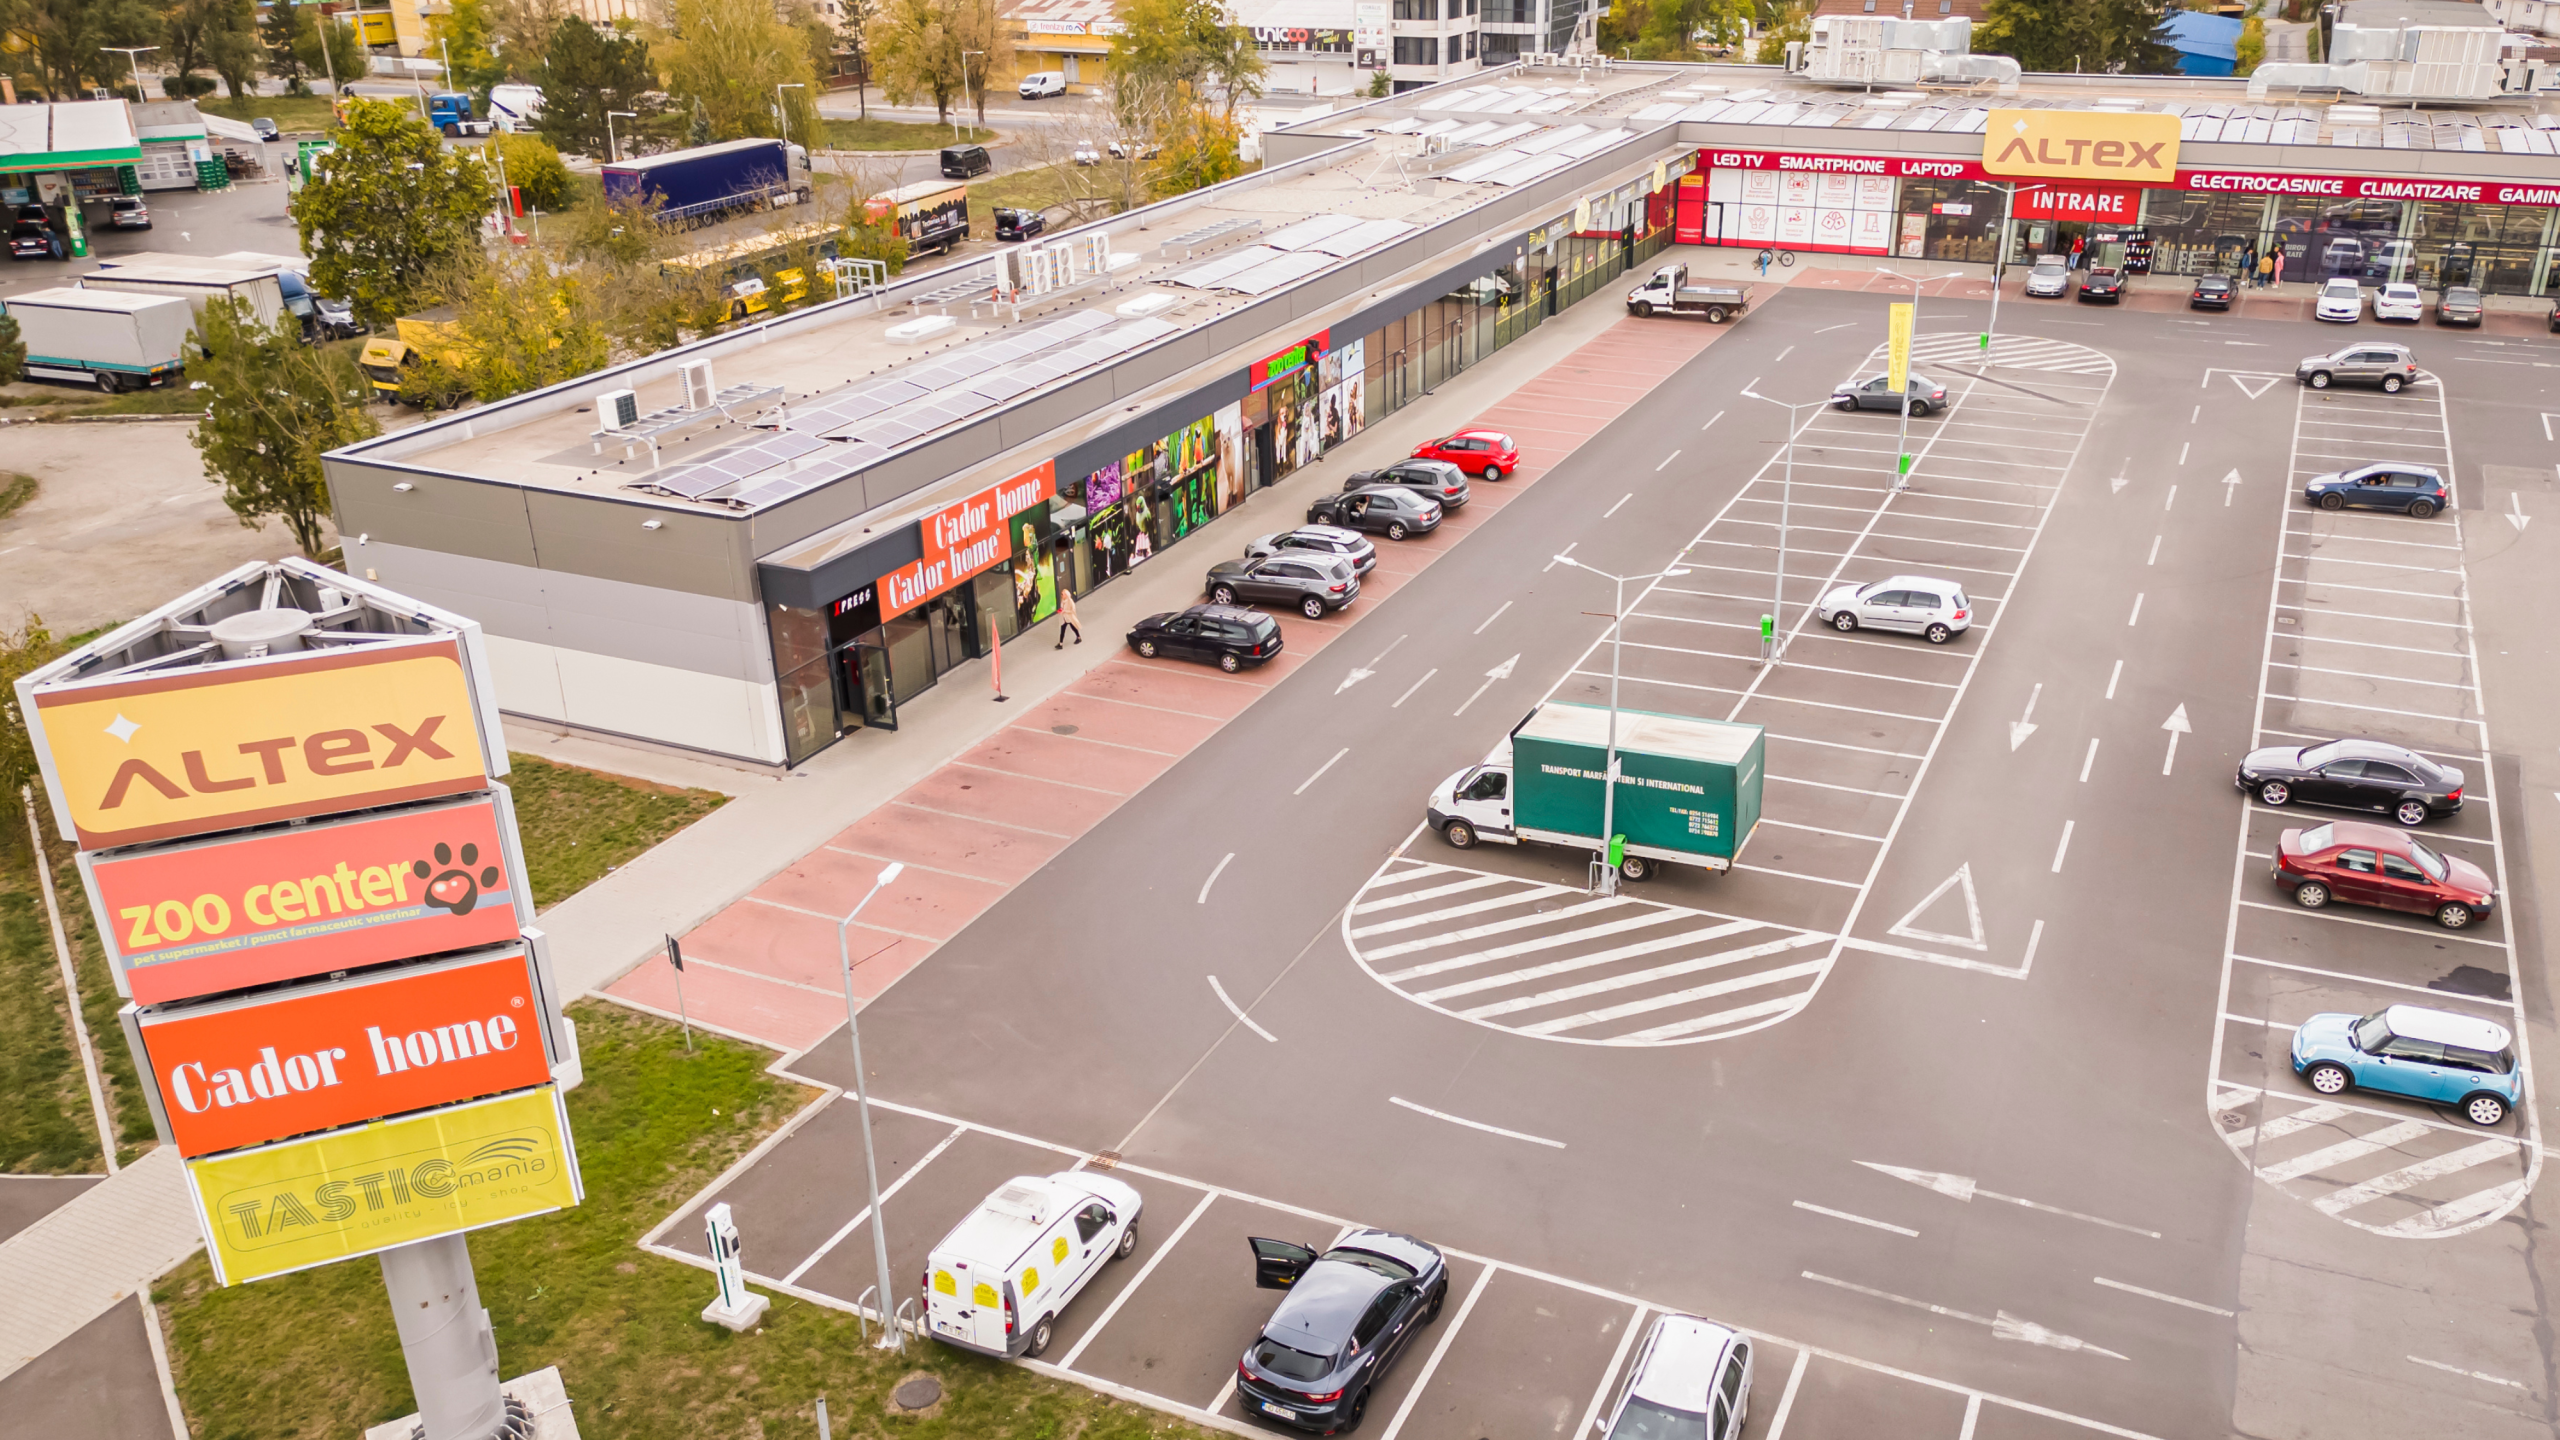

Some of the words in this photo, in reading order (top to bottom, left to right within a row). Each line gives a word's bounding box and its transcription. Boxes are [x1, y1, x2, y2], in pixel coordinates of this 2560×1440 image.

[1713, 153, 1741, 166] LED
[1743, 154, 1764, 168] TV
[1779, 156, 1885, 173] SMARTPHONE
[1901, 161, 1964, 176] LAPTOP
[2190, 174, 2343, 194] ELECTROCASNICE
[2359, 182, 2481, 200] CLIMATIZARE
[2032, 191, 2125, 212] INTRARE
[934, 502, 989, 549] Cador
[995, 478, 1041, 521] home
[888, 560, 946, 609] Cador
[948, 535, 999, 580] home
[834, 588, 871, 617] XPRESS
[1541, 764, 1581, 777] TRANSPORT
[1637, 777, 1644, 787] SI
[1646, 778, 1705, 795] INTERNATIONAL
[120, 893, 232, 948] zoo
[244, 861, 411, 926] center
[133, 954, 157, 967] pet
[159, 938, 241, 961] supermarket
[251, 930, 288, 946] punct
[290, 917, 364, 938] farmaceutic
[366, 907, 422, 926] veterinar
[171, 1046, 346, 1113] Cador
[365, 1014, 518, 1076] home
[229, 1158, 459, 1239] TASTIC
[459, 1157, 545, 1188] mania
[361, 1209, 422, 1230] quality
[490, 1185, 529, 1199] shop
